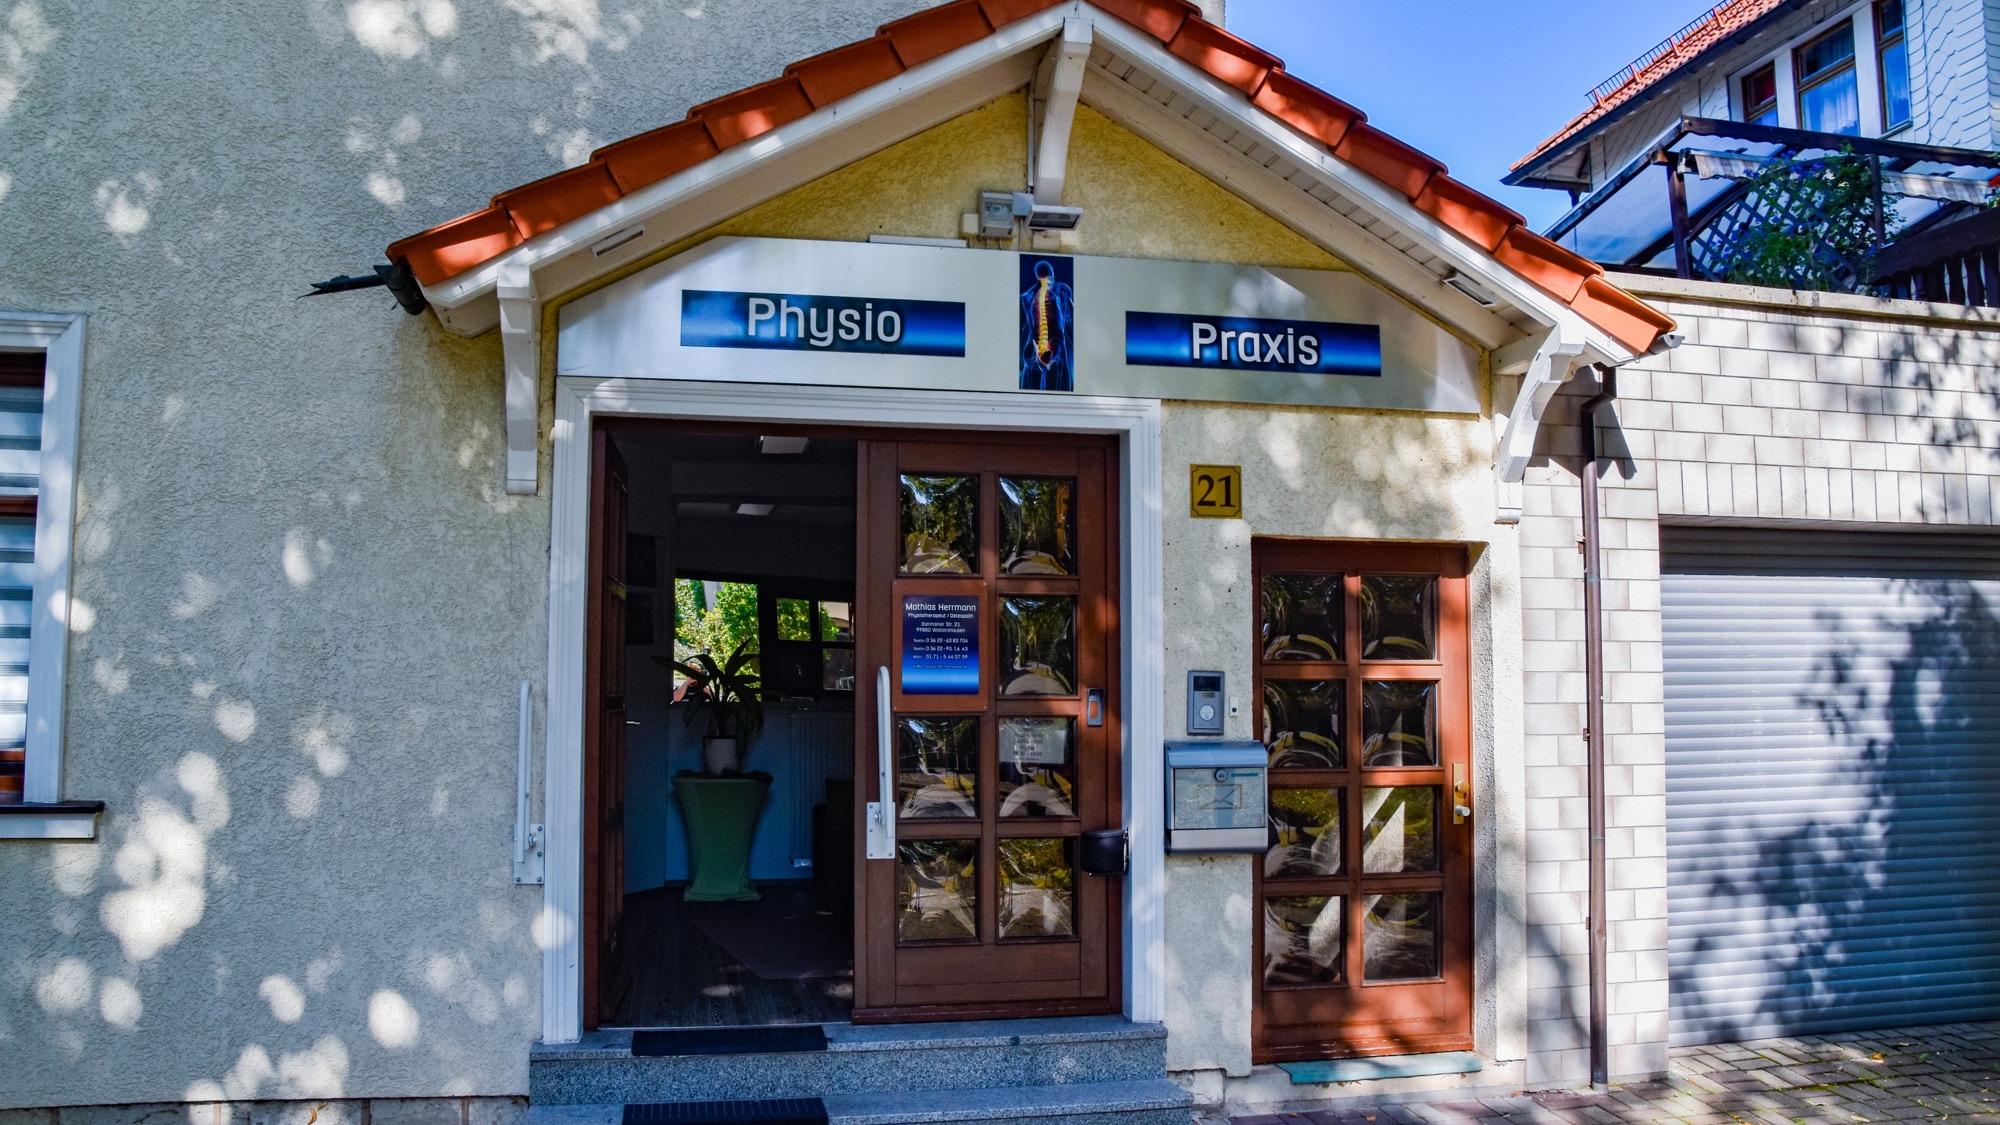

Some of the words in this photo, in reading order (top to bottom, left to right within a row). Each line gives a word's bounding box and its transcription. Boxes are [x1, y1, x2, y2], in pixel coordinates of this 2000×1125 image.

[748, 297, 901, 347] Physio
[1192, 322, 1318, 366] Praxis
[1197, 474, 1236, 507] 21
[905, 603, 936, 611] Mathias
[938, 603, 976, 611] Herrmann
